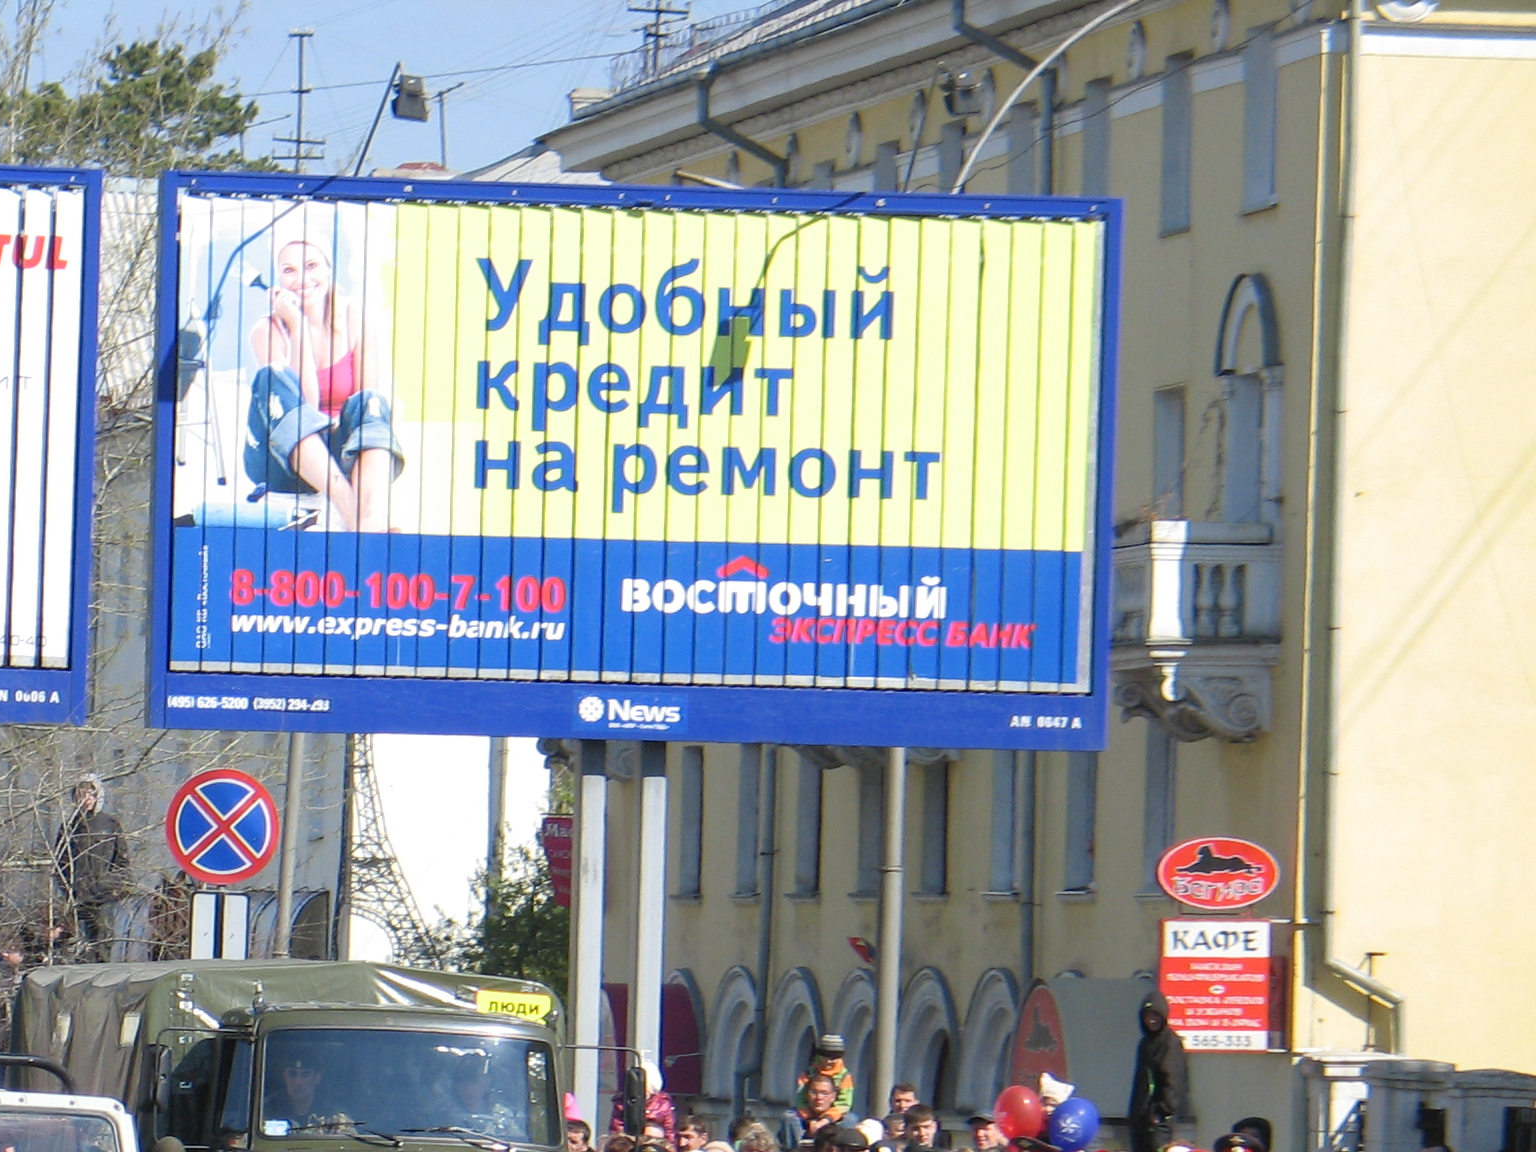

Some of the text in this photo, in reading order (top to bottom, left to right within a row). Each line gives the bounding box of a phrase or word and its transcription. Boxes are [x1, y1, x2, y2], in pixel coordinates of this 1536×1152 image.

[477, 257, 895, 345] Удобный
[477, 360, 794, 431] кредит
[474, 439, 941, 513] на ремонт
[230, 568, 565, 613] 8-800-100-7-100
[230, 613, 565, 640] www.express-bank.ru
[769, 617, 1034, 648] ЭКСПРЕСС БАНК
[167, 694, 195, 708] (495)
[197, 695, 249, 709] 626-5200
[252, 696, 286, 711] (3952)
[607, 698, 681, 723] News
[1172, 930, 1259, 951] КАФЕ
[488, 1000, 540, 1015] ЛЮДИ
